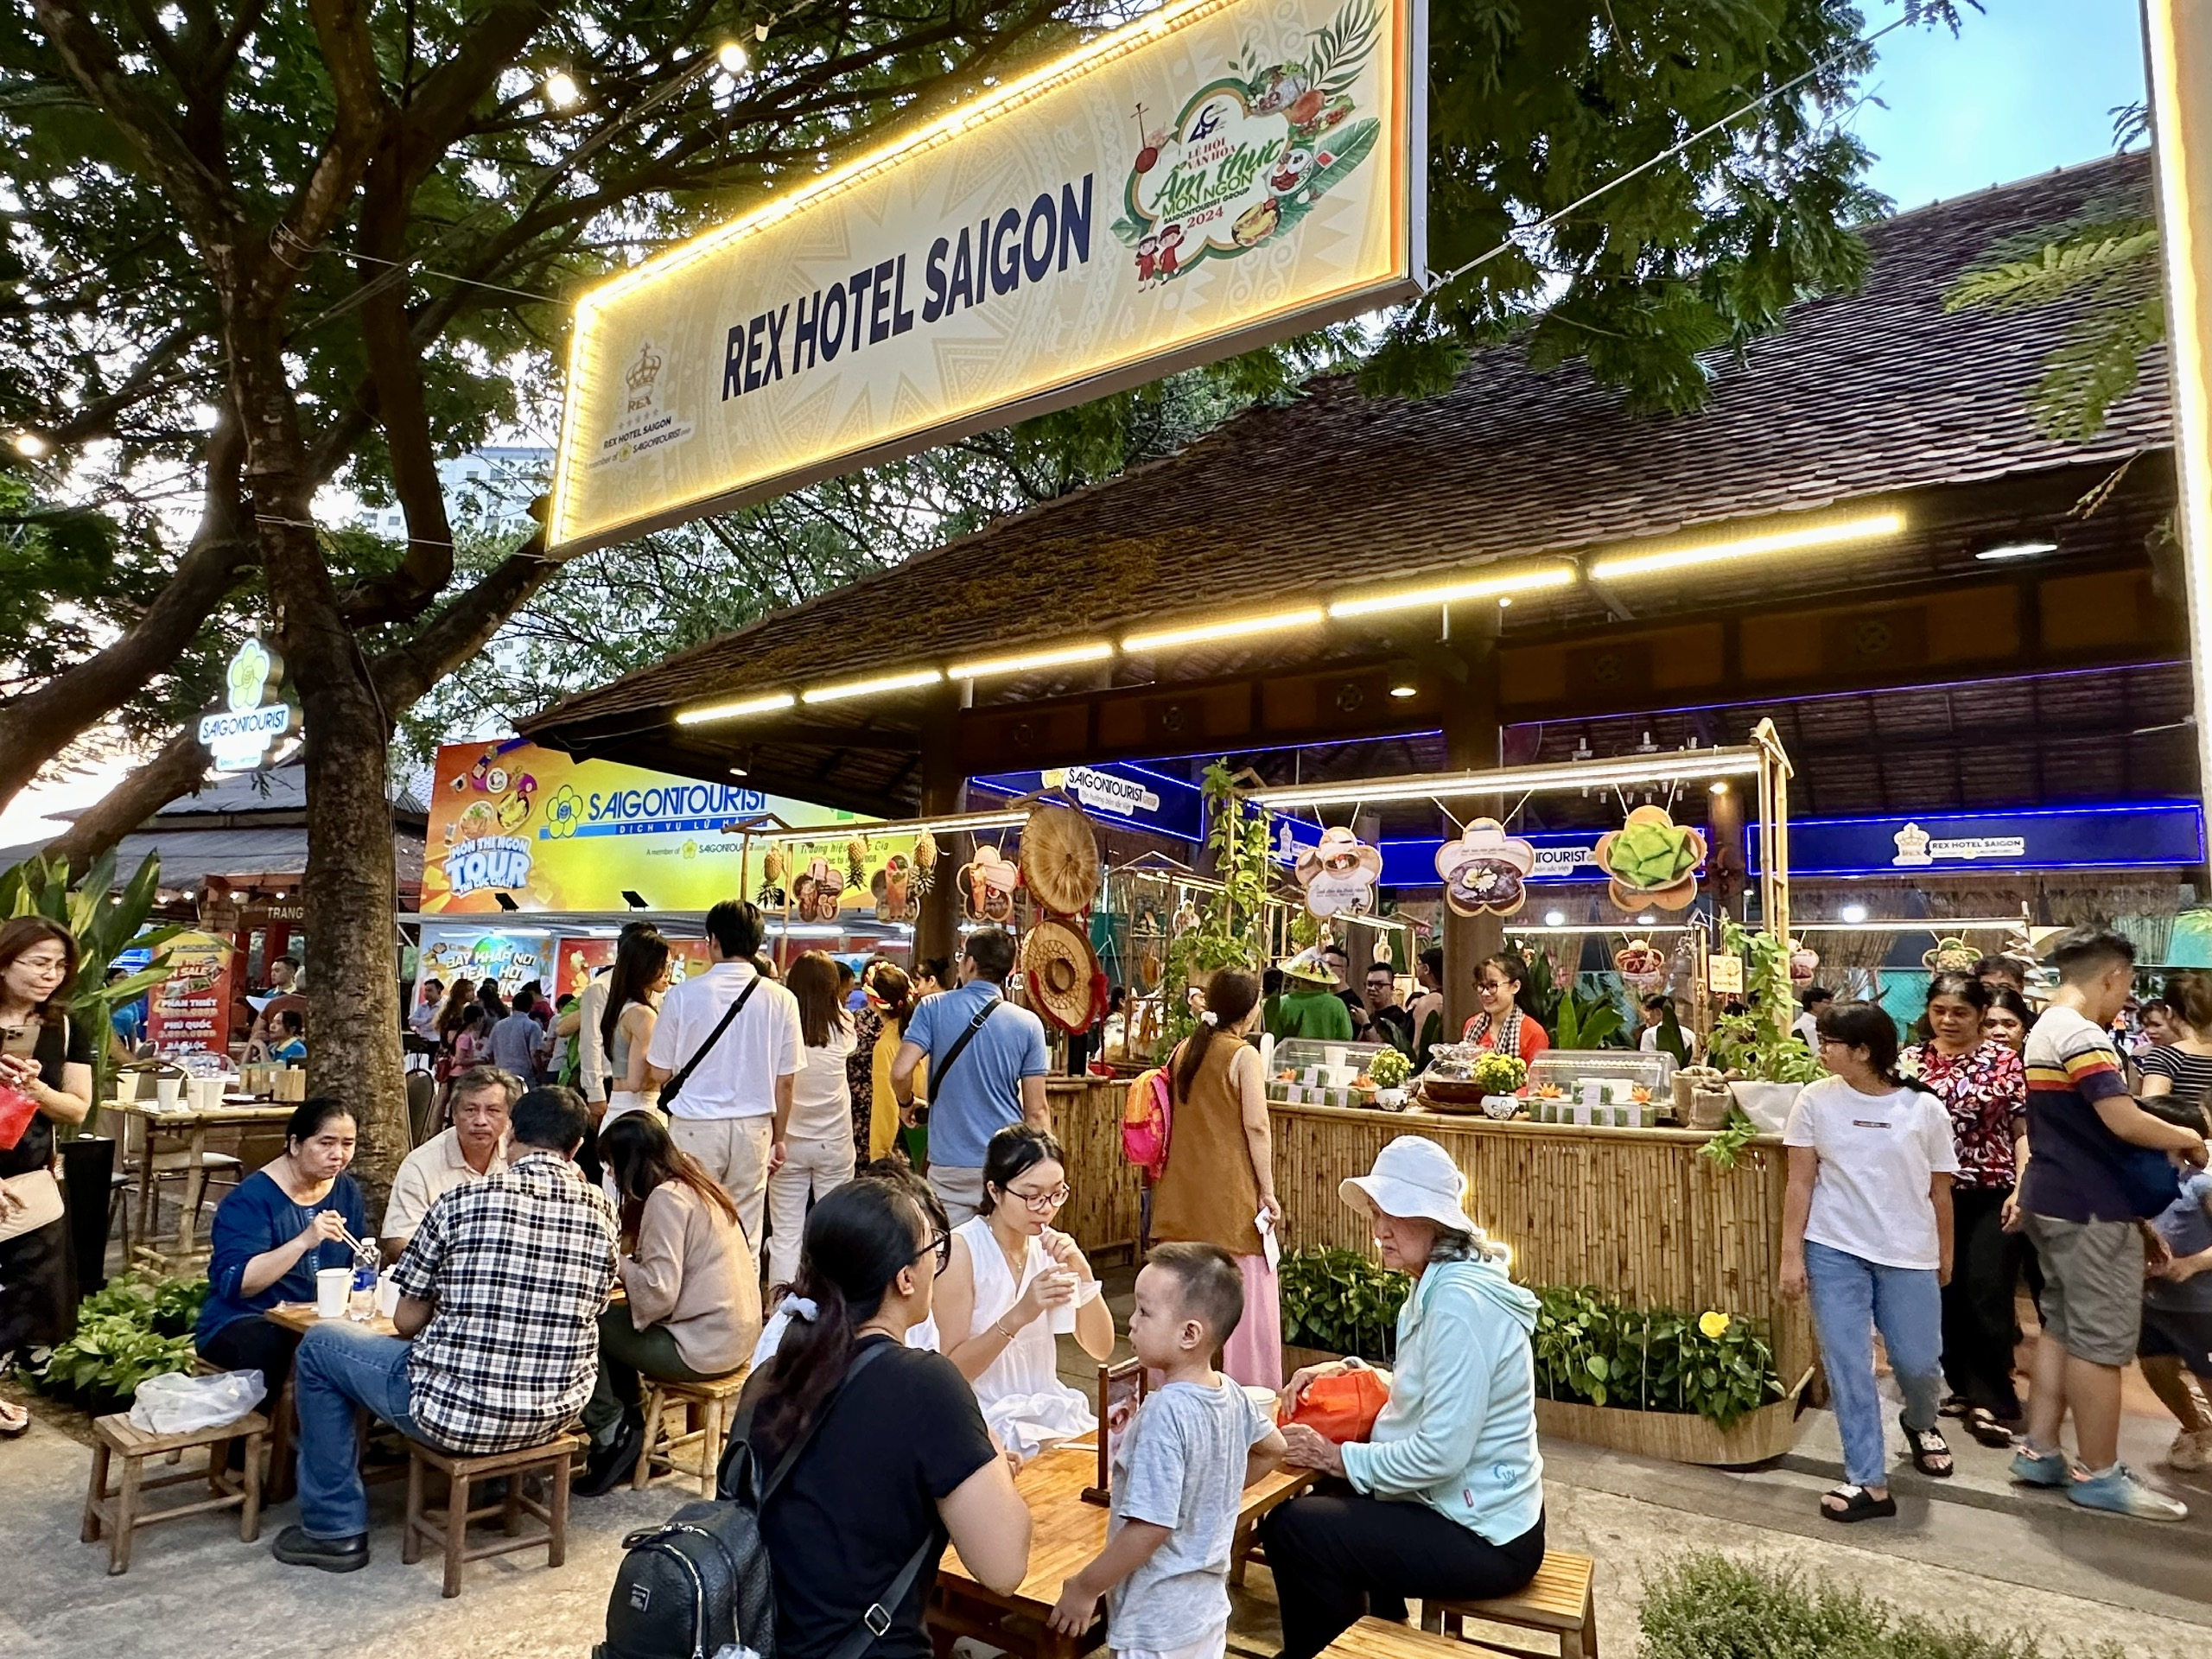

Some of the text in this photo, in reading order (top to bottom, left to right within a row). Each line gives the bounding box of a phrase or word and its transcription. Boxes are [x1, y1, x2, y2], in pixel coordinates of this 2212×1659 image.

[1204, 169, 1255, 201] NGON
[1223, 187, 1250, 202] GROUP
[1187, 206, 1224, 229] 2024
[721, 173, 1093, 402] REX HOTEL SAIGON
[627, 396, 652, 413] REX
[603, 436, 618, 450] REX
[618, 429, 642, 444] HOTEL
[643, 416, 672, 435] SAIGON
[632, 428, 682, 454] SAIGONTOURIST
[202, 709, 286, 740] SAIGONTOURIST
[1069, 768, 1143, 803] SAIGONTOURIST
[1535, 850, 1587, 863] TOURIST
[445, 851, 530, 893] TOUR
[268, 906, 304, 919] TRANG
[180, 967, 209, 977] SALE
